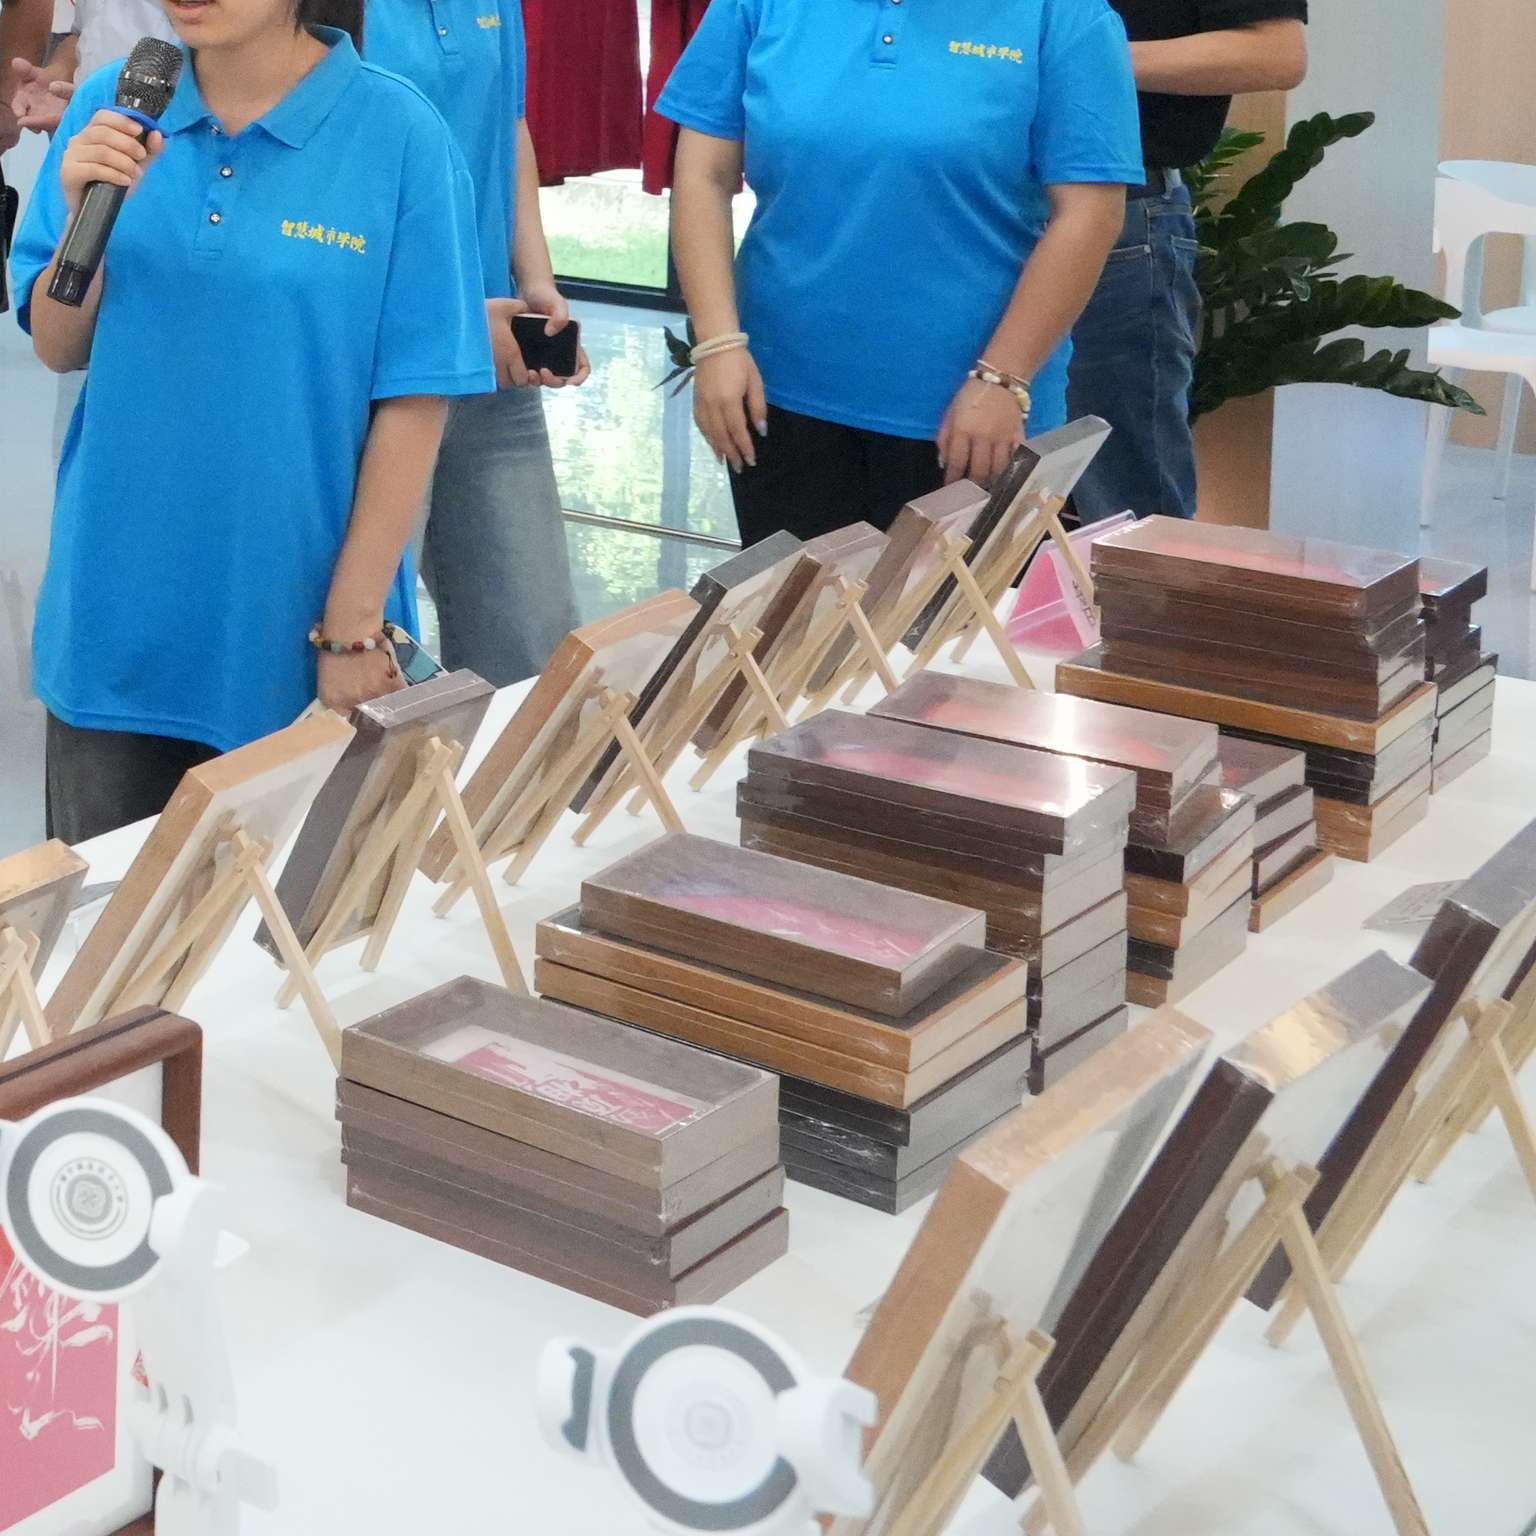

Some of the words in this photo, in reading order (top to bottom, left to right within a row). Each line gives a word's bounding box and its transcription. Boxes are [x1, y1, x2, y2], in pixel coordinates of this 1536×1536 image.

[281, 219, 367, 254] 智慧城市学院
